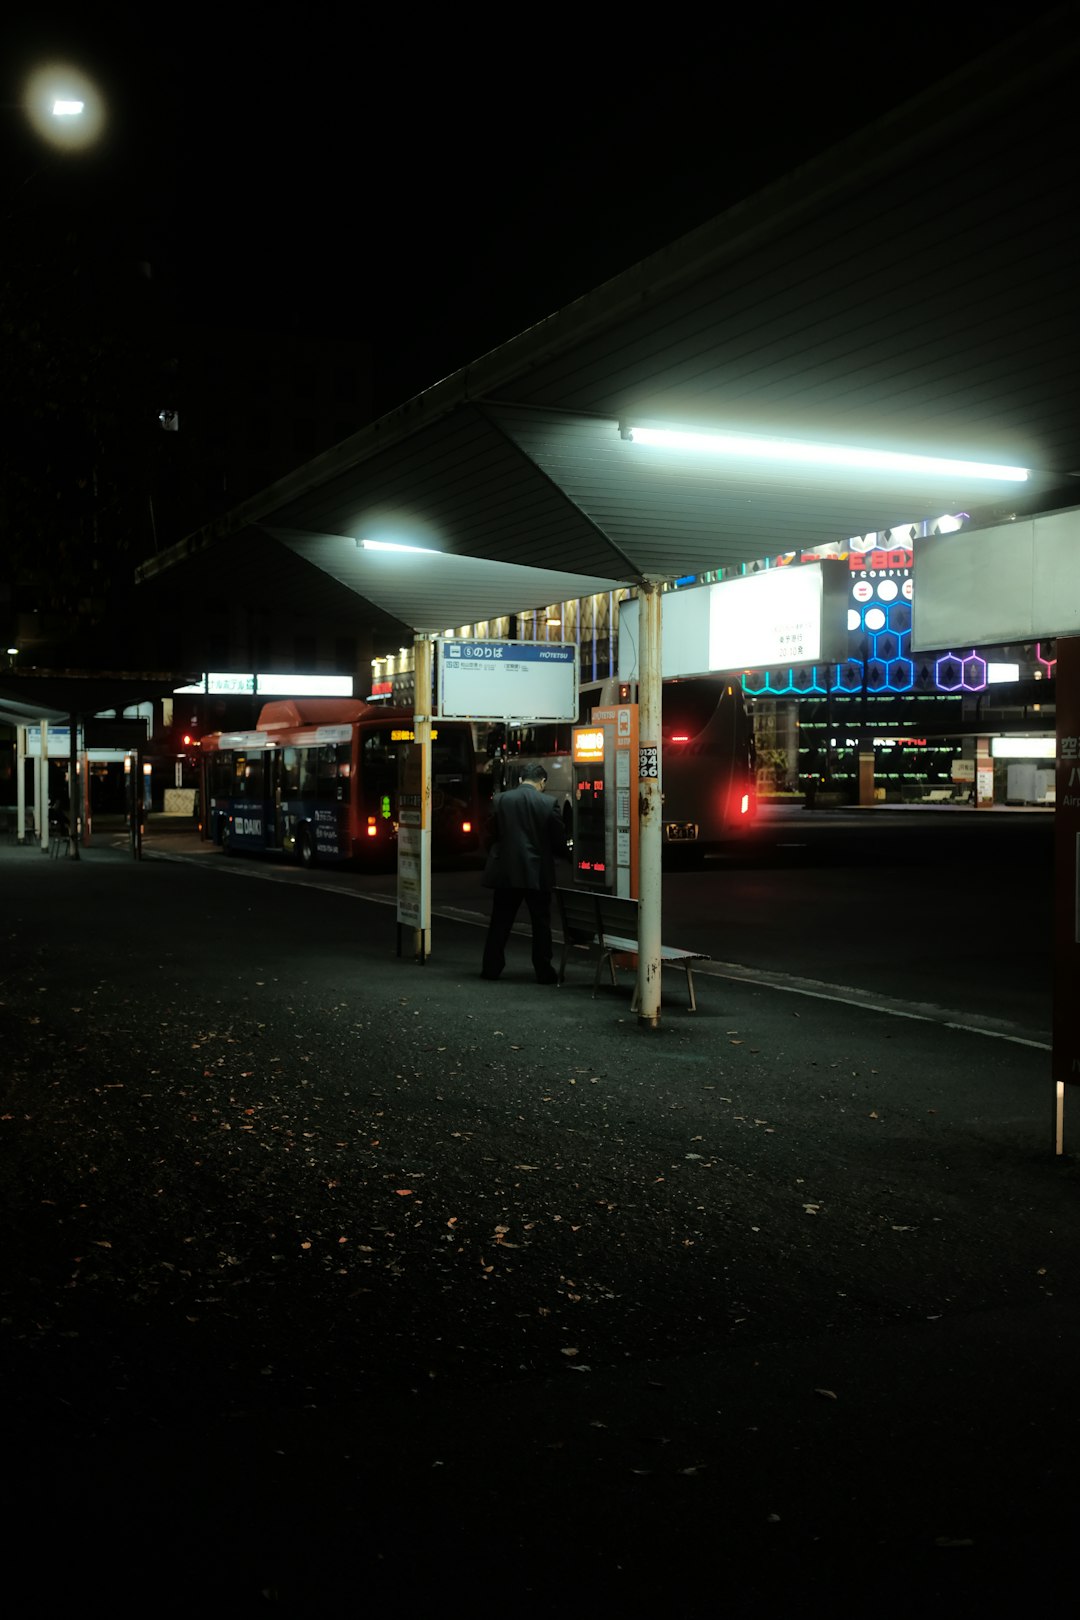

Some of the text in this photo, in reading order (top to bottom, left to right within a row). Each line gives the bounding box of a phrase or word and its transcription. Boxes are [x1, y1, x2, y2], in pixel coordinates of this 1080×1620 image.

[640, 748, 657, 756] 0120
[639, 755, 657, 766] 94
[639, 766, 658, 777] 66
